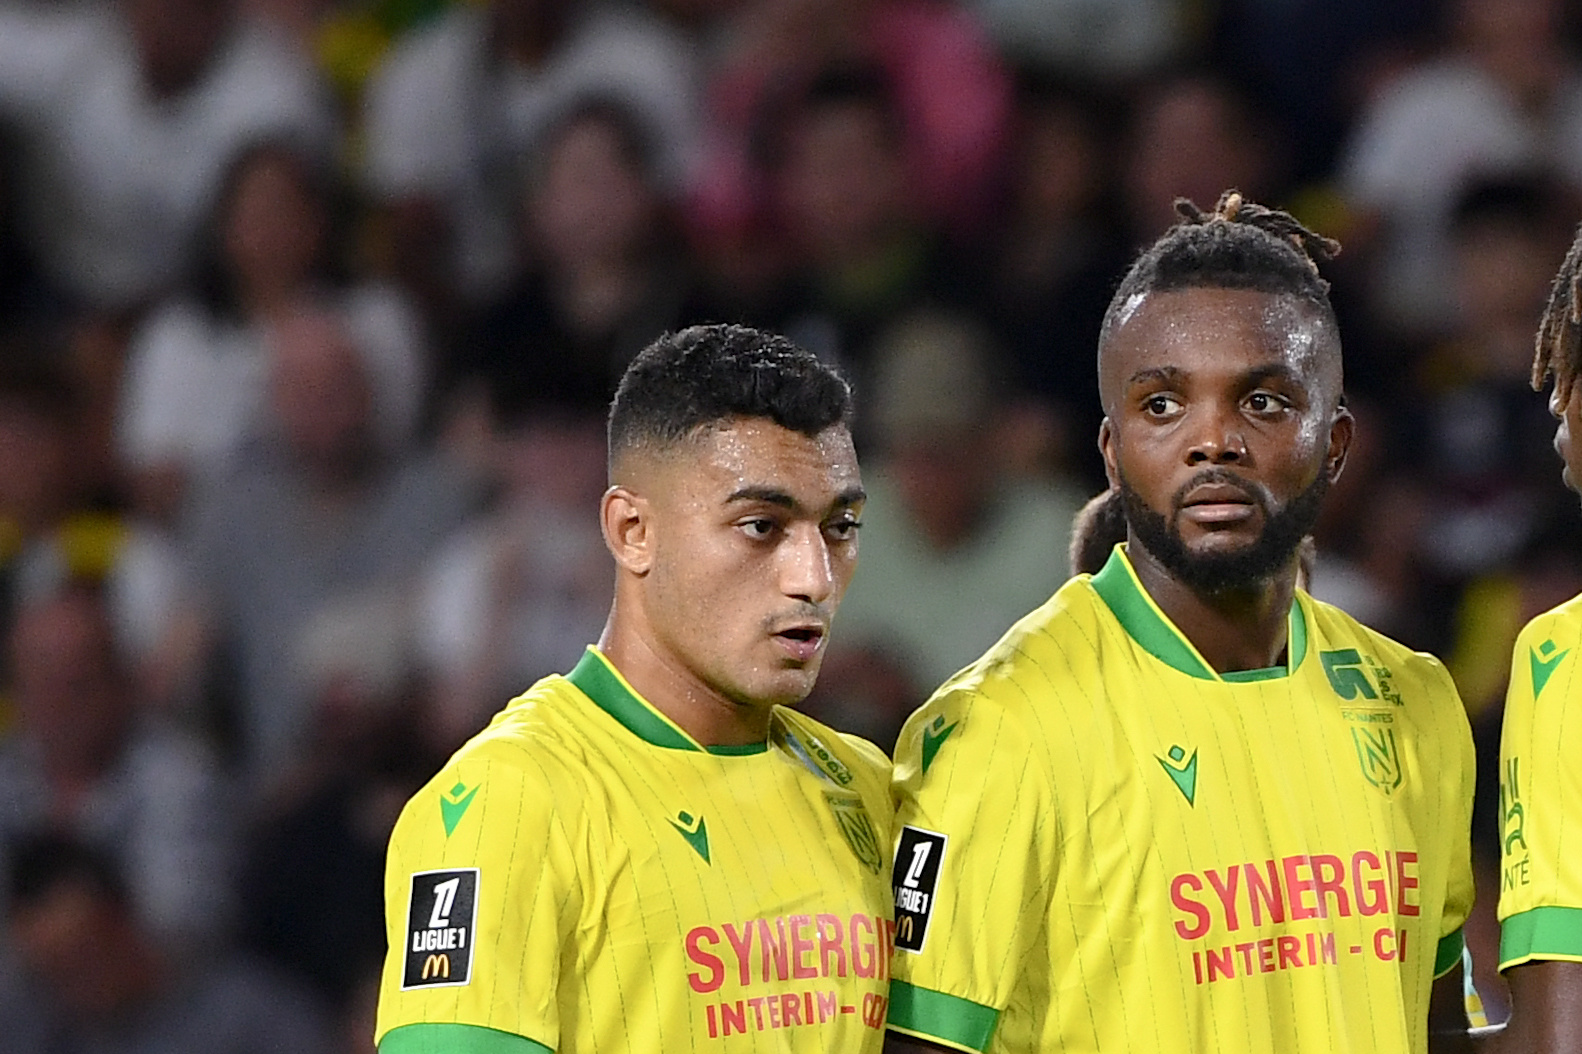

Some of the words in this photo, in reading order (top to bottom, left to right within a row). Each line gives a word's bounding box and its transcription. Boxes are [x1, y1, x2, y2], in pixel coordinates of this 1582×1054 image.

[1170, 850, 1420, 941] SYNERGIE
[1192, 932, 1337, 985] INTERIM
[707, 991, 837, 1038] INTERIM
